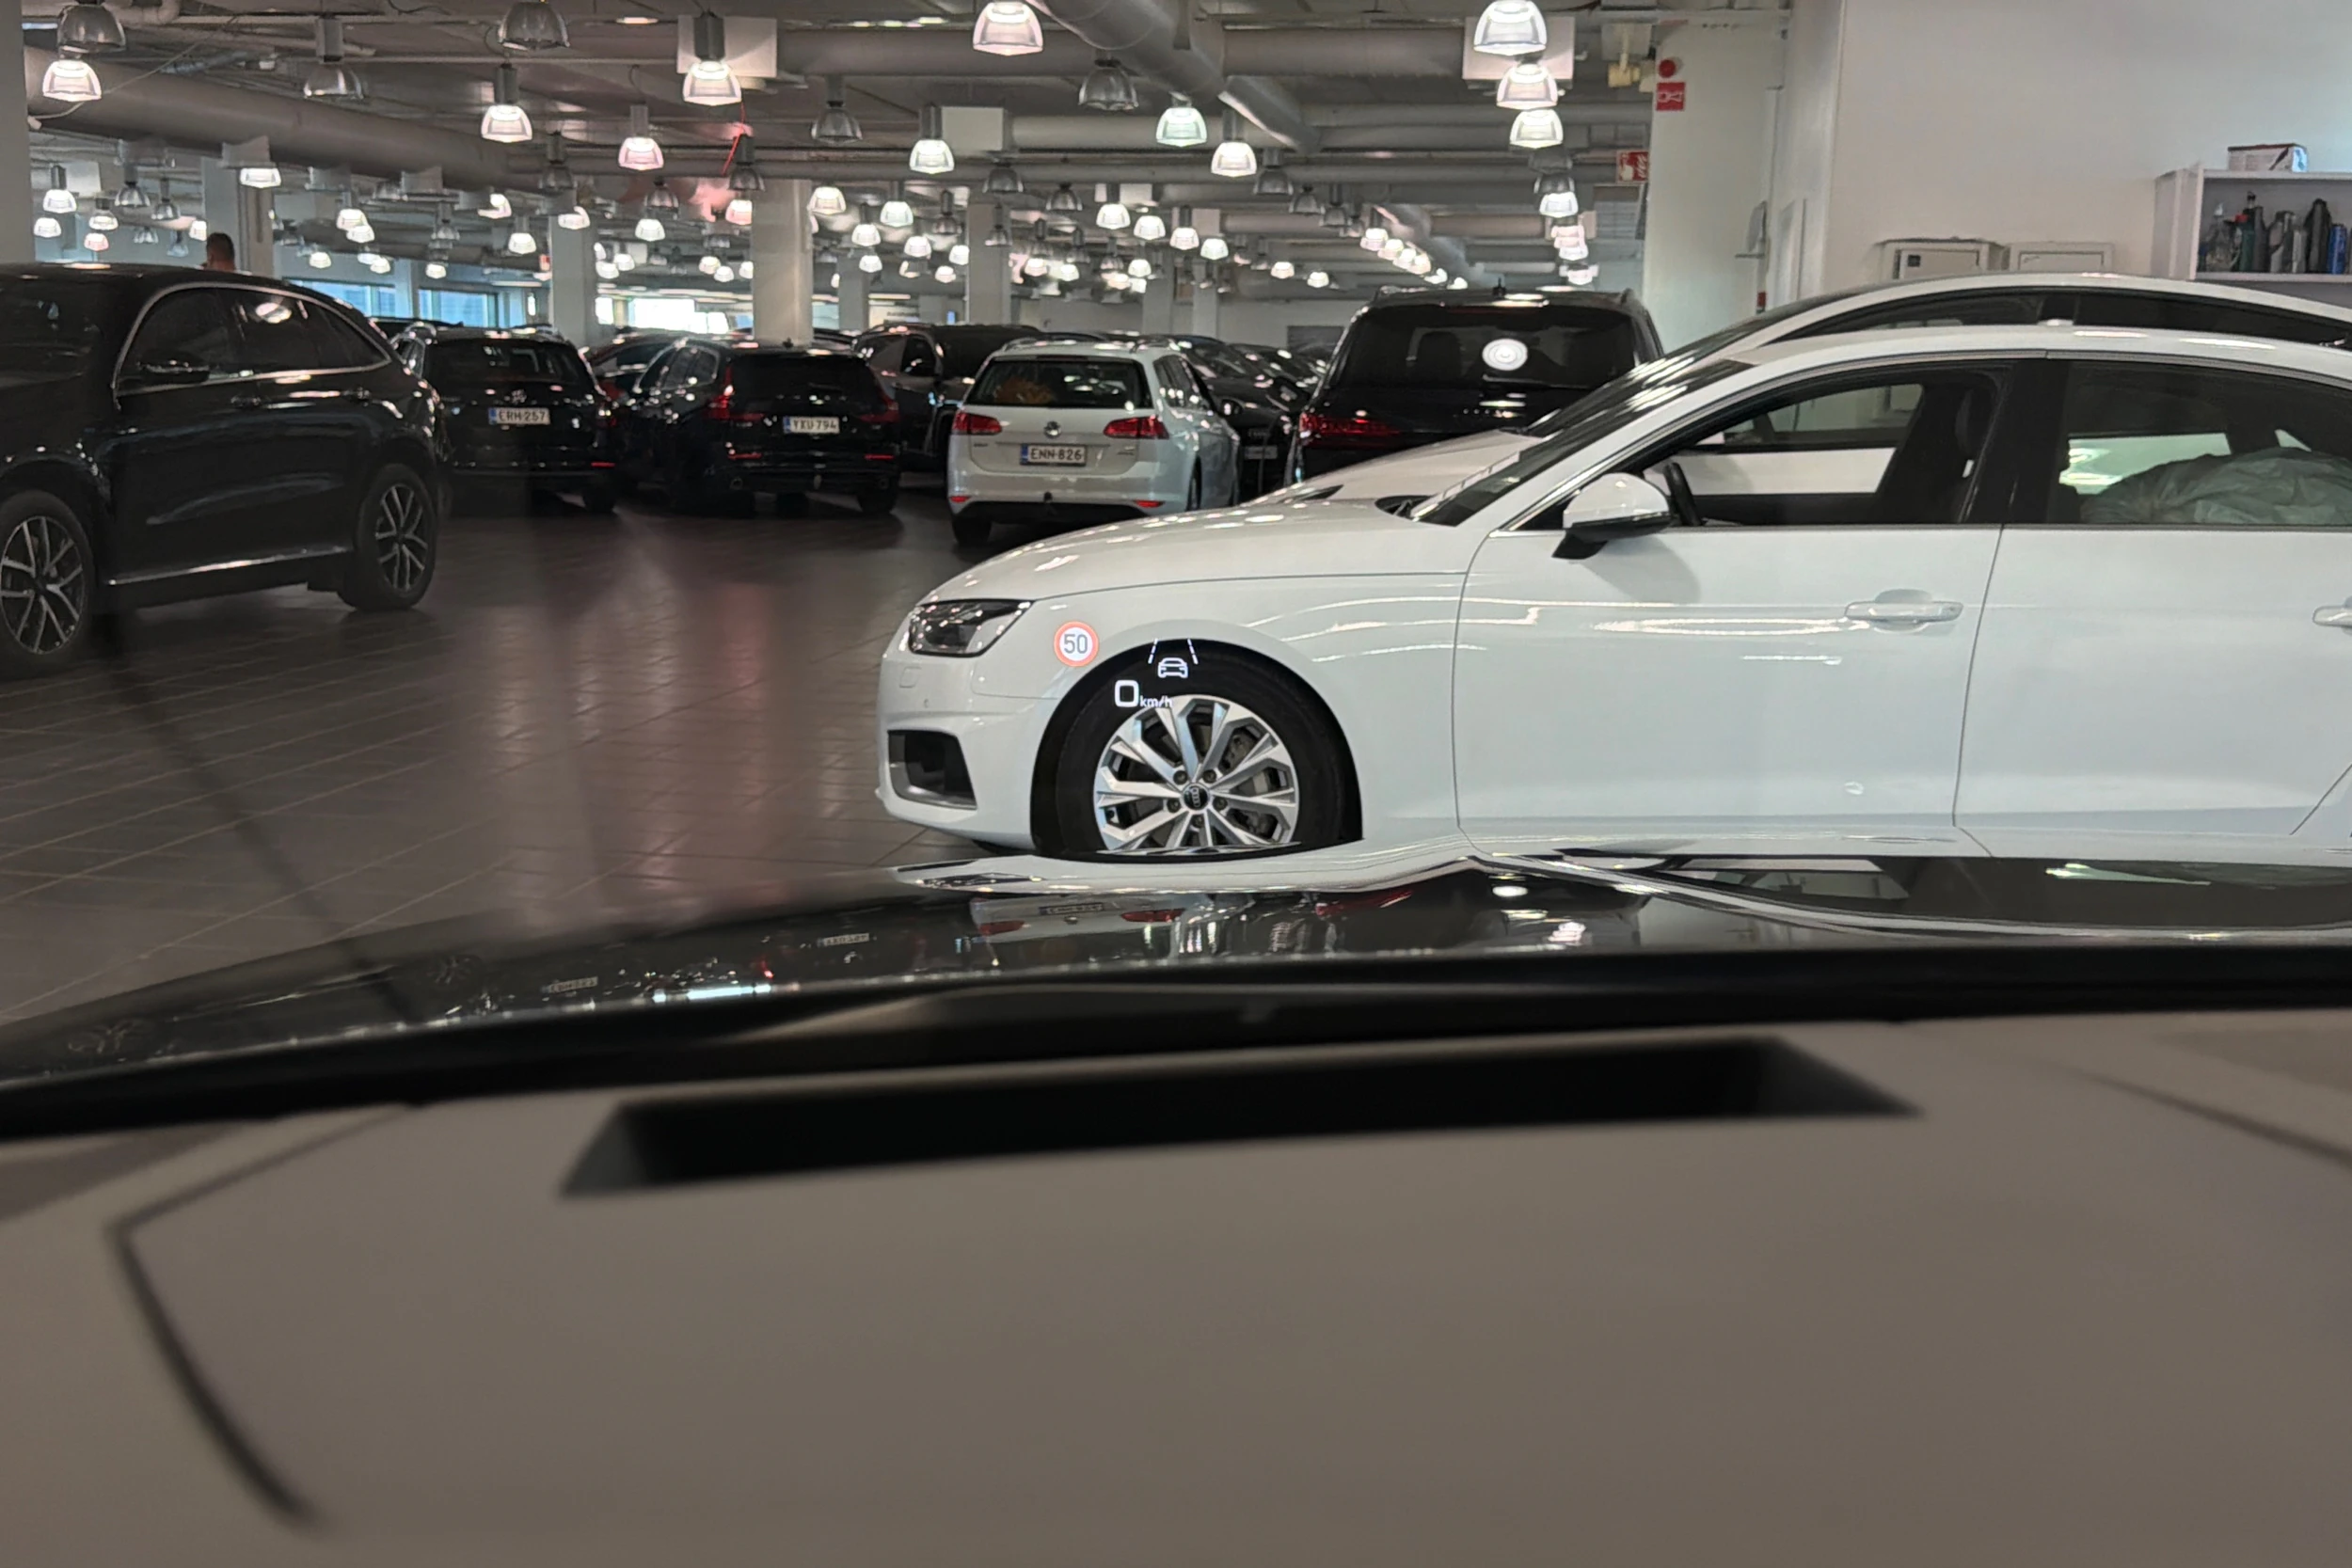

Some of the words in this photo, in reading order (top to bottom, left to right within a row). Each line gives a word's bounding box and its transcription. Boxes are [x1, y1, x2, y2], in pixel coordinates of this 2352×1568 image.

[1030, 447, 1083, 461] ENN-826
[1063, 633, 1089, 655] 50
[1114, 679, 1139, 707] 0
[1139, 694, 1173, 707] km/h
